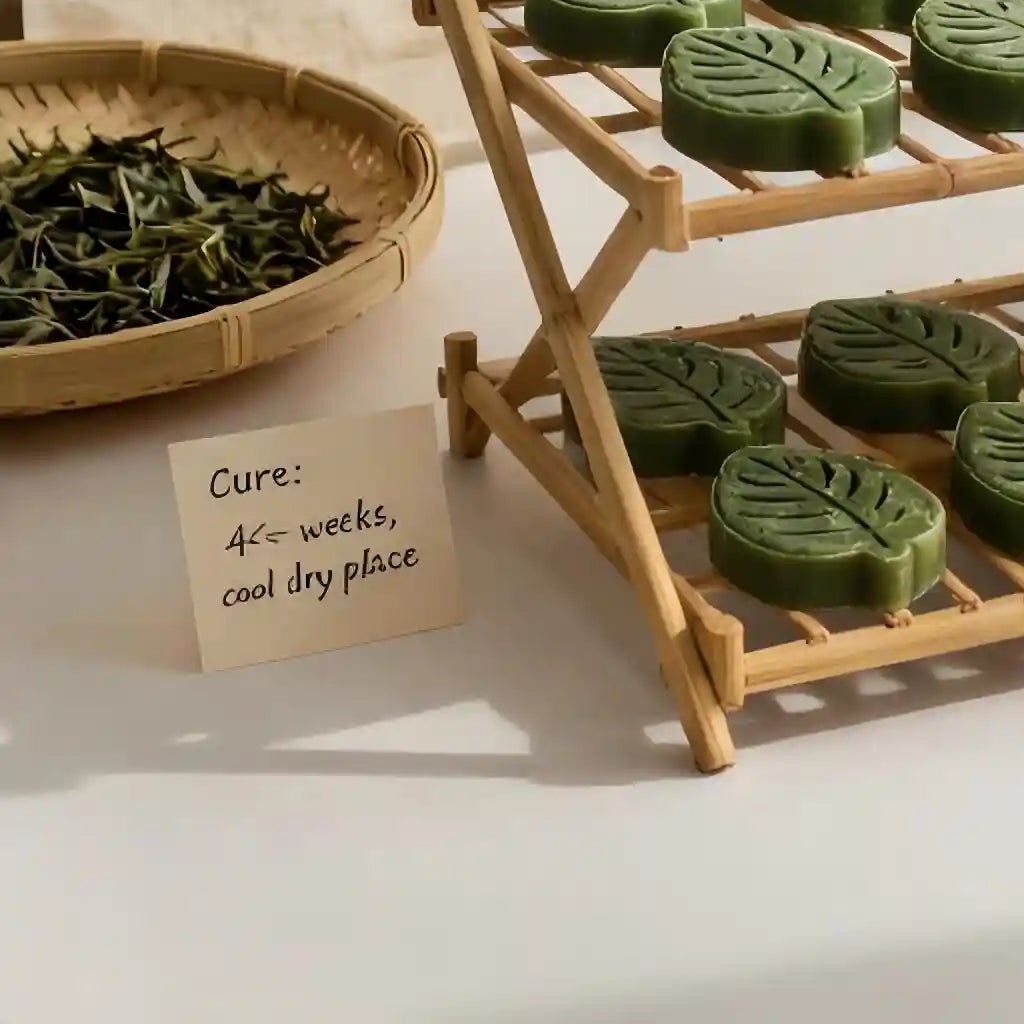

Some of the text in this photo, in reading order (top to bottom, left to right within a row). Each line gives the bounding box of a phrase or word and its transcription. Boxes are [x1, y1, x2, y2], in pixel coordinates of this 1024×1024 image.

[209, 463, 302, 499] Cure:
[300, 498, 398, 543] weeks,
[222, 546, 420, 607] cool dry place
